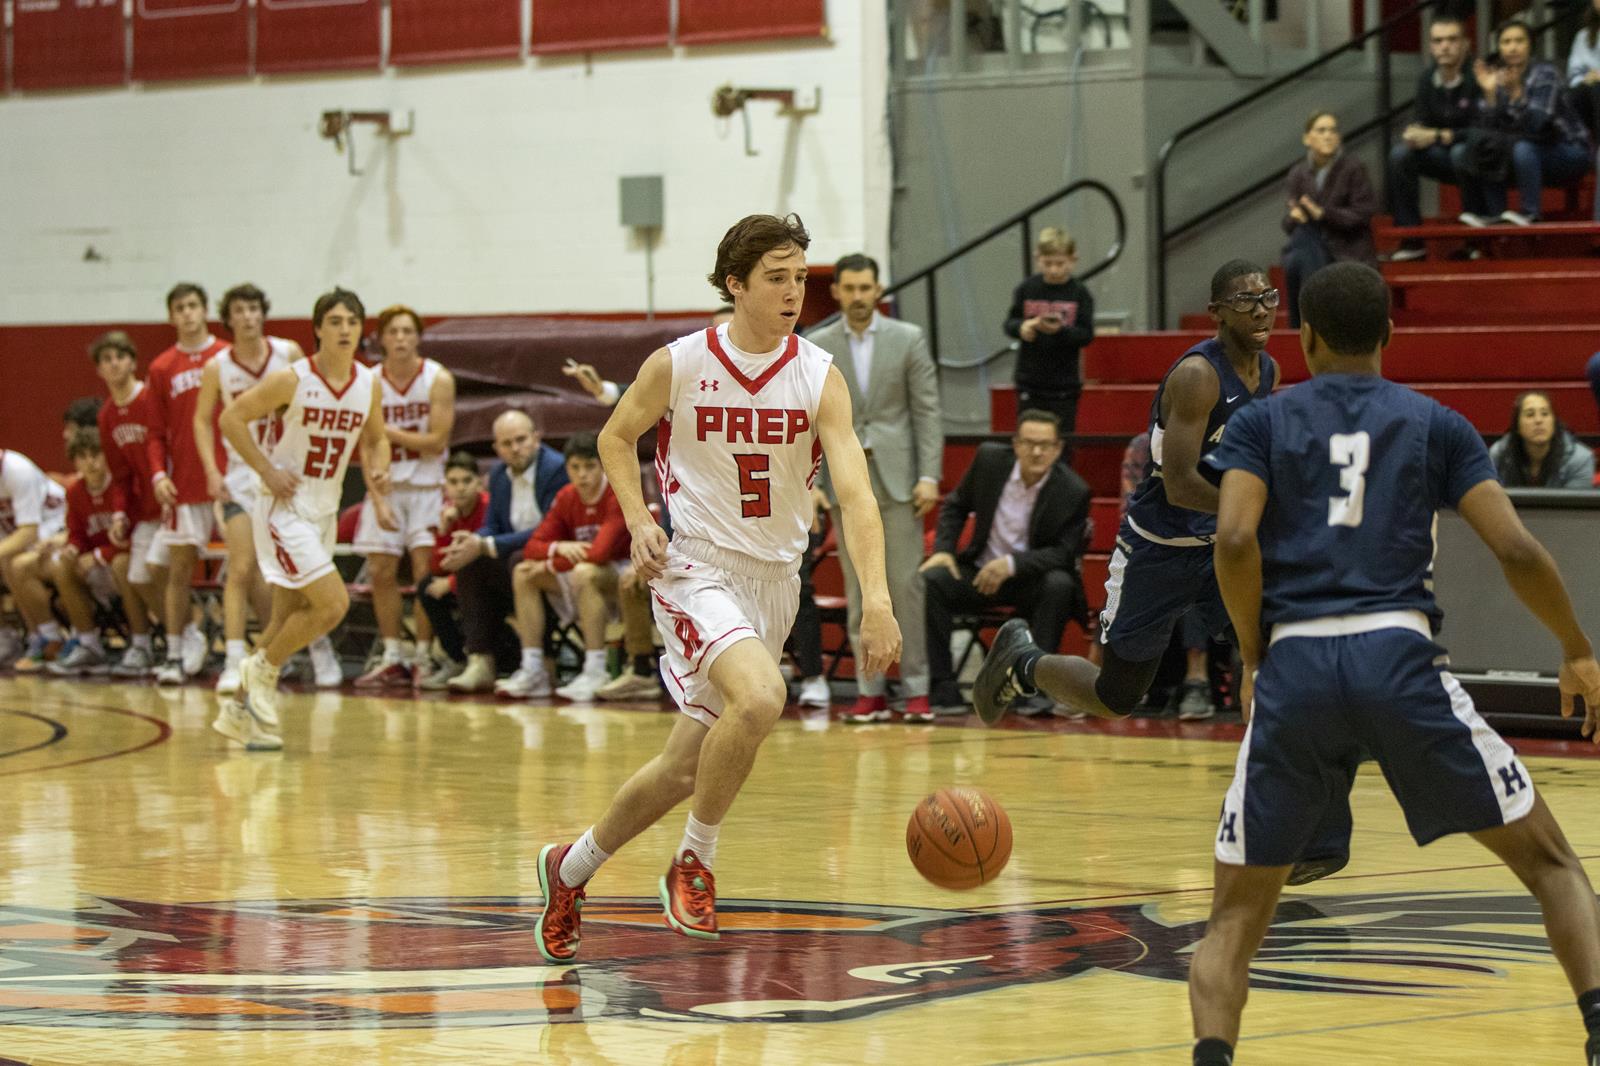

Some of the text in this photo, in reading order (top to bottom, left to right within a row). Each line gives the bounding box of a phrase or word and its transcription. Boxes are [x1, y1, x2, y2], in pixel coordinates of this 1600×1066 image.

[302, 406, 363, 432] PREP
[694, 406, 809, 445] PREP
[303, 434, 346, 479] 23
[733, 453, 771, 518] 5
[1328, 431, 1370, 528] 3
[1497, 761, 1527, 798] H
[1218, 812, 1237, 843] H
